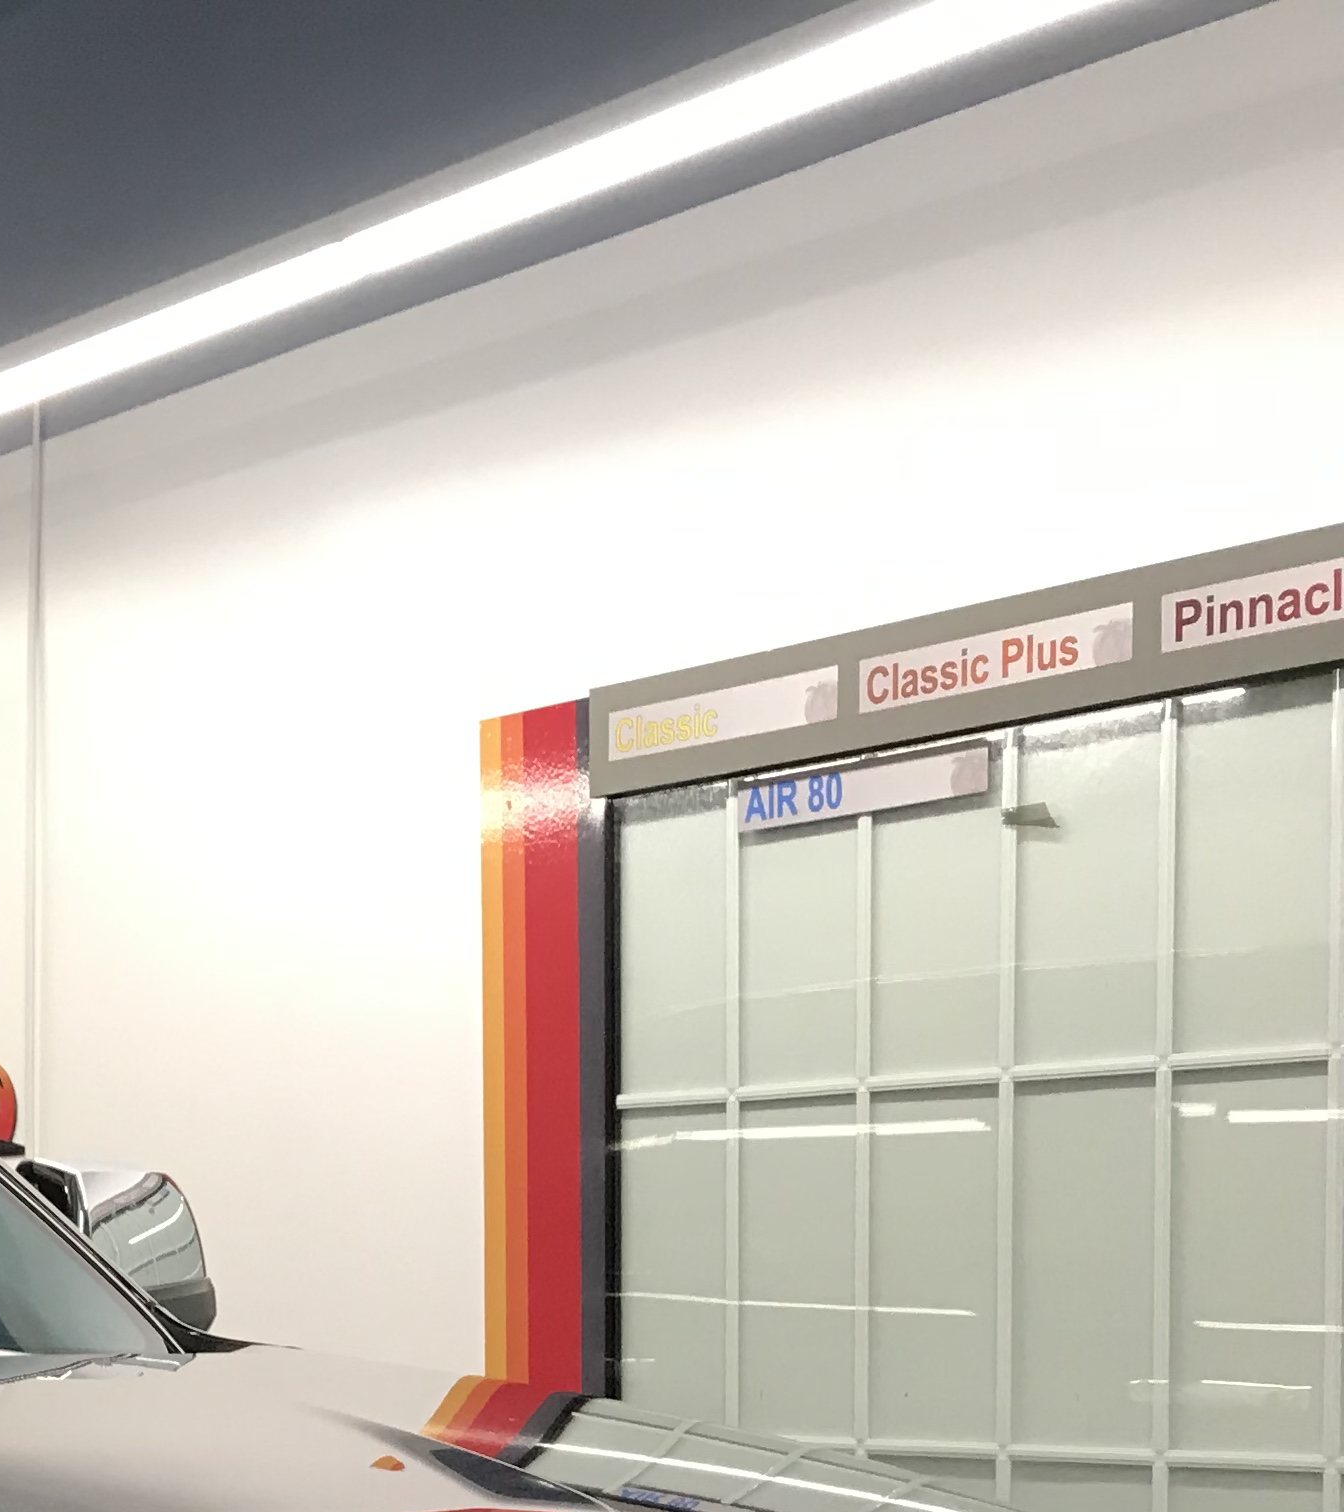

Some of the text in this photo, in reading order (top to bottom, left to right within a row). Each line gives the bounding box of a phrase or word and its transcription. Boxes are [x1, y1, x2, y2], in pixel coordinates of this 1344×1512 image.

[1174, 567, 1343, 643] Pinnacl
[866, 634, 1080, 706] Classic Plus
[615, 703, 719, 753] Classic
[744, 771, 844, 824] AIR 80
